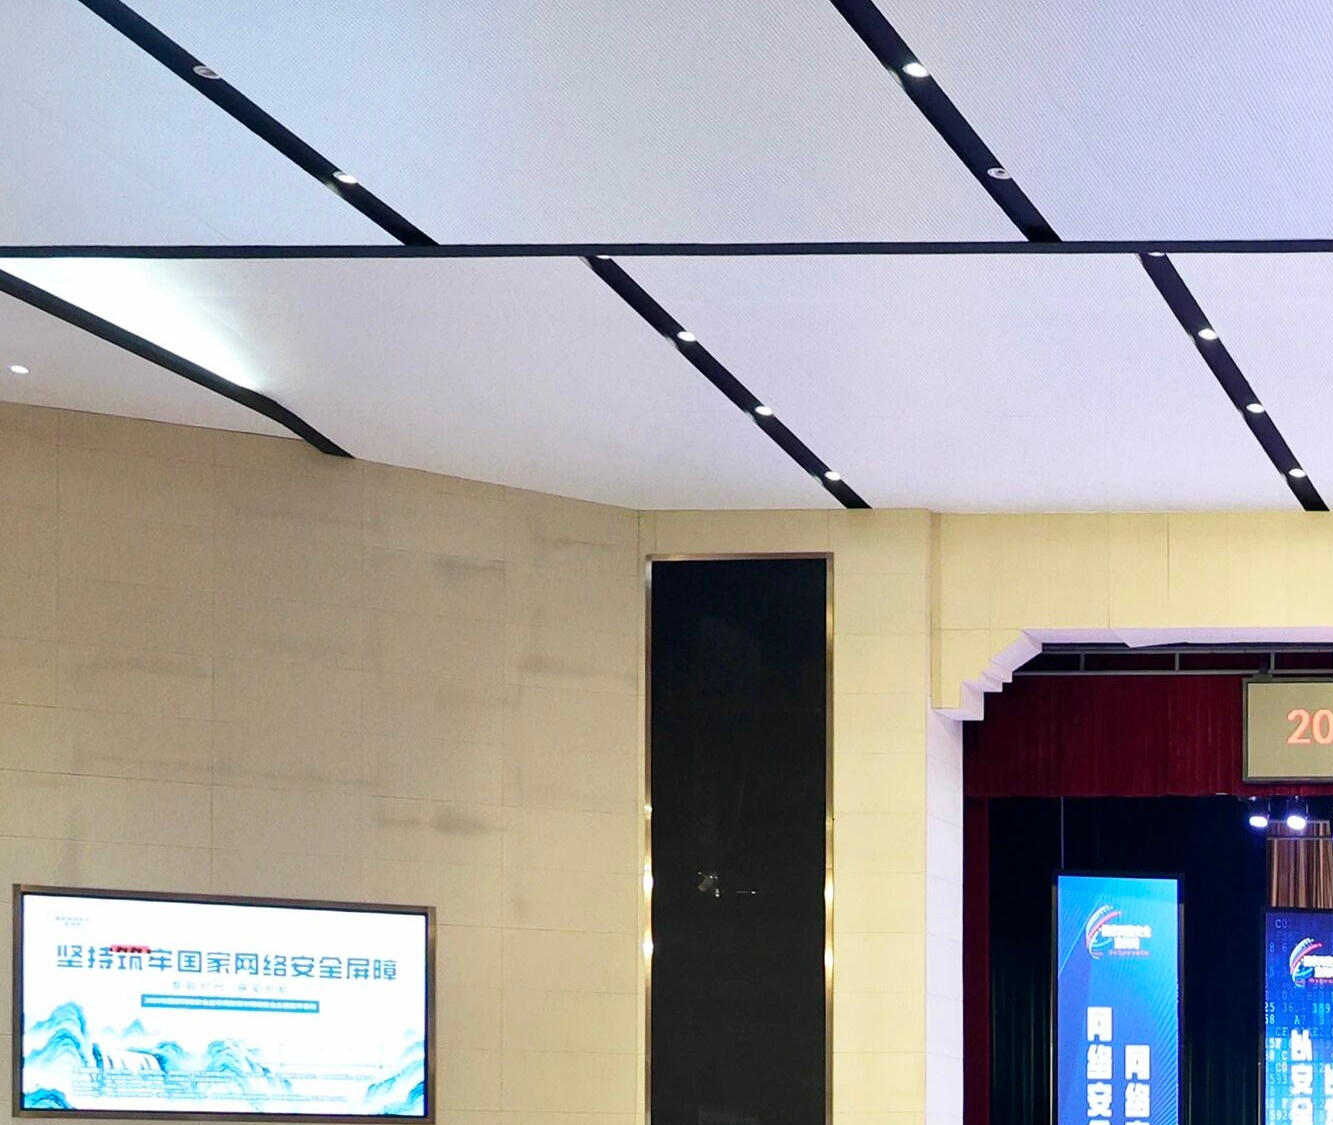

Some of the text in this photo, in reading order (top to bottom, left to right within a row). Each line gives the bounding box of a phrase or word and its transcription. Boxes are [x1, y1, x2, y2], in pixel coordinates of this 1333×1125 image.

[57, 945, 397, 981] 坚持筑牢国家网络安全屏障
